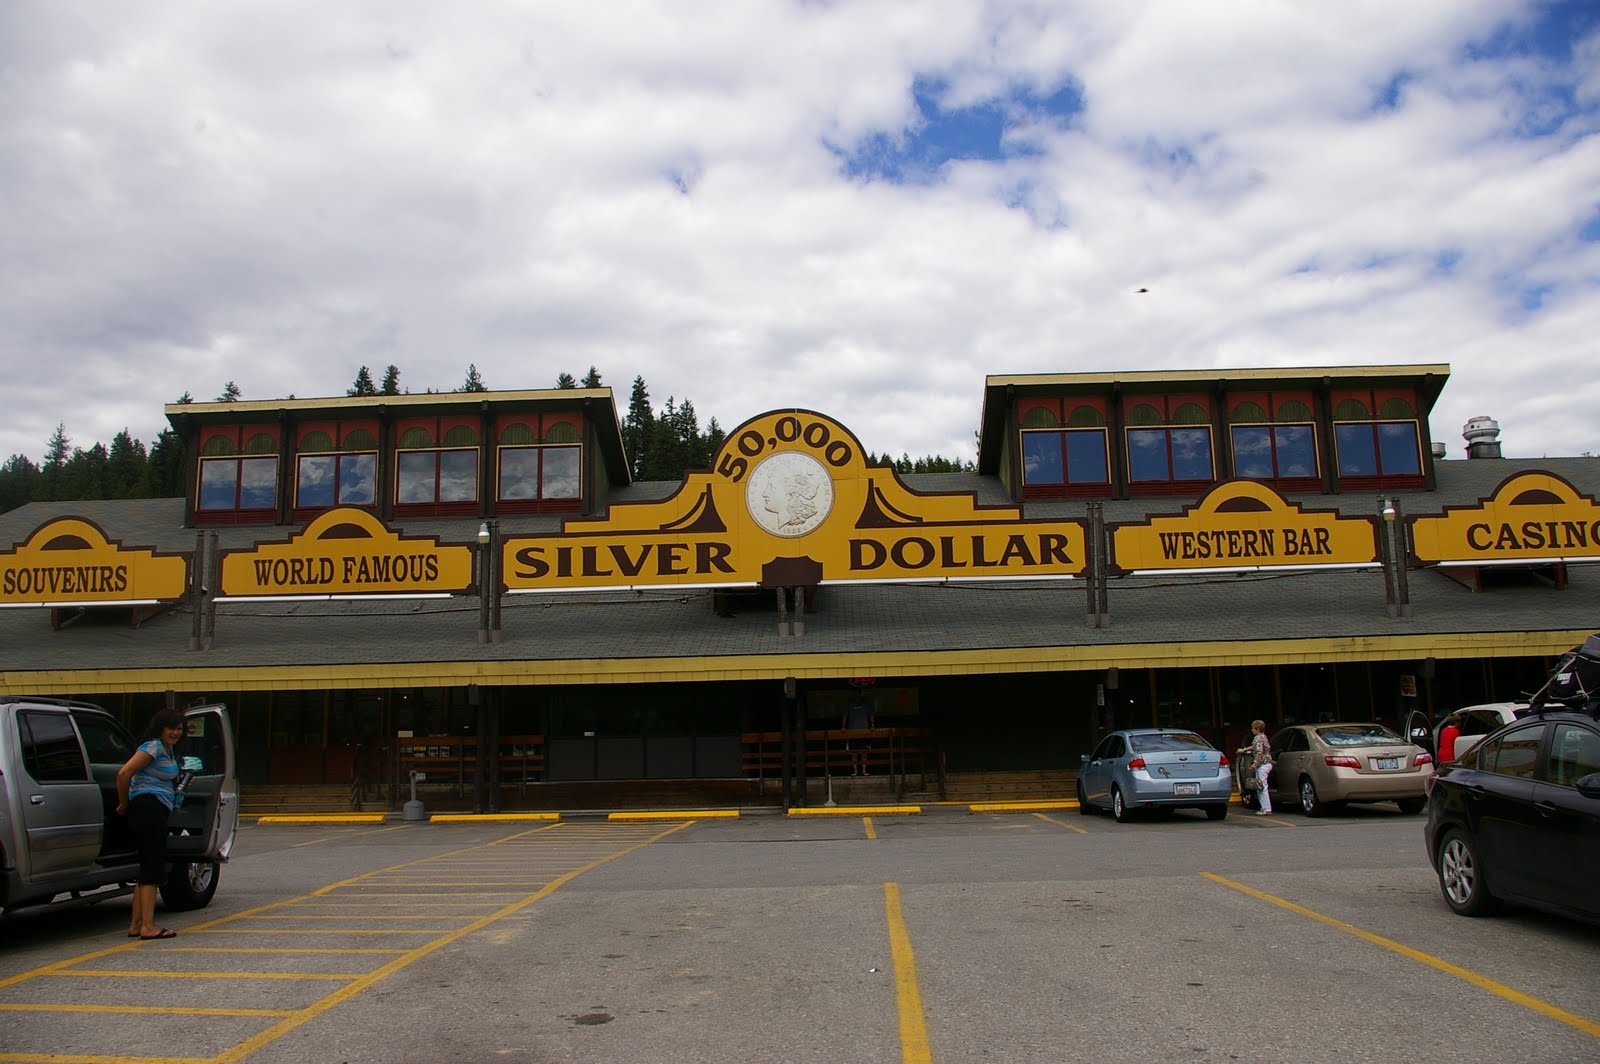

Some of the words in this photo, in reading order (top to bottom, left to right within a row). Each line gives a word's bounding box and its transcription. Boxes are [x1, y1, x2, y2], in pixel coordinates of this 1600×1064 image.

[717, 416, 852, 483] 50,000
[515, 542, 736, 578] SILVER
[848, 533, 1074, 570] DOLLAR
[1159, 529, 1274, 559] WESTERN
[1283, 527, 1332, 555] BAR
[3, 565, 127, 594] SOUVENIRS
[254, 557, 334, 586] WORLD
[342, 554, 439, 583] FAMOUS
